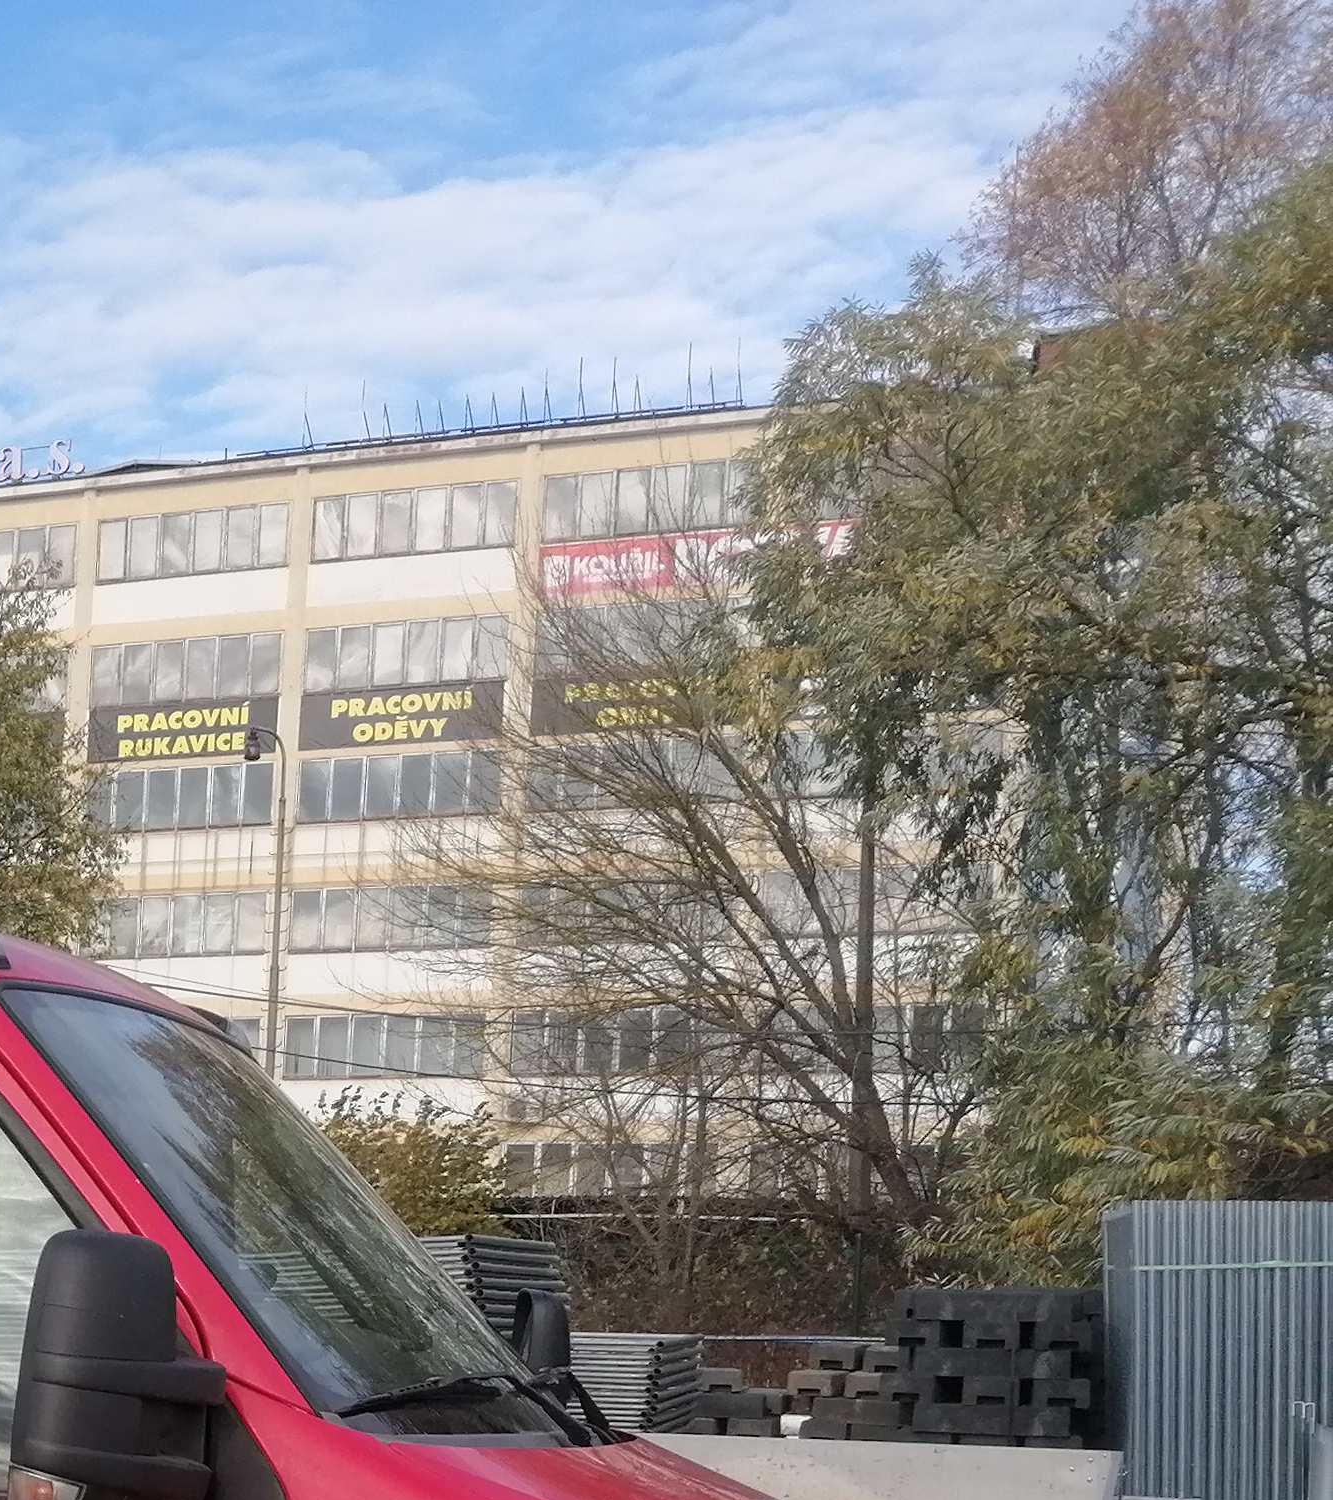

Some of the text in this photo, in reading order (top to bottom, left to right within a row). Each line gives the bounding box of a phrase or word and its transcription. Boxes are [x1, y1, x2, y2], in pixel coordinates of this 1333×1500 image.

[117, 701, 250, 733] PRACOVNÍ
[331, 685, 473, 719] PRACOVNÍ
[352, 714, 447, 743] ODĚVY
[118, 731, 245, 759] RUKAVICE
